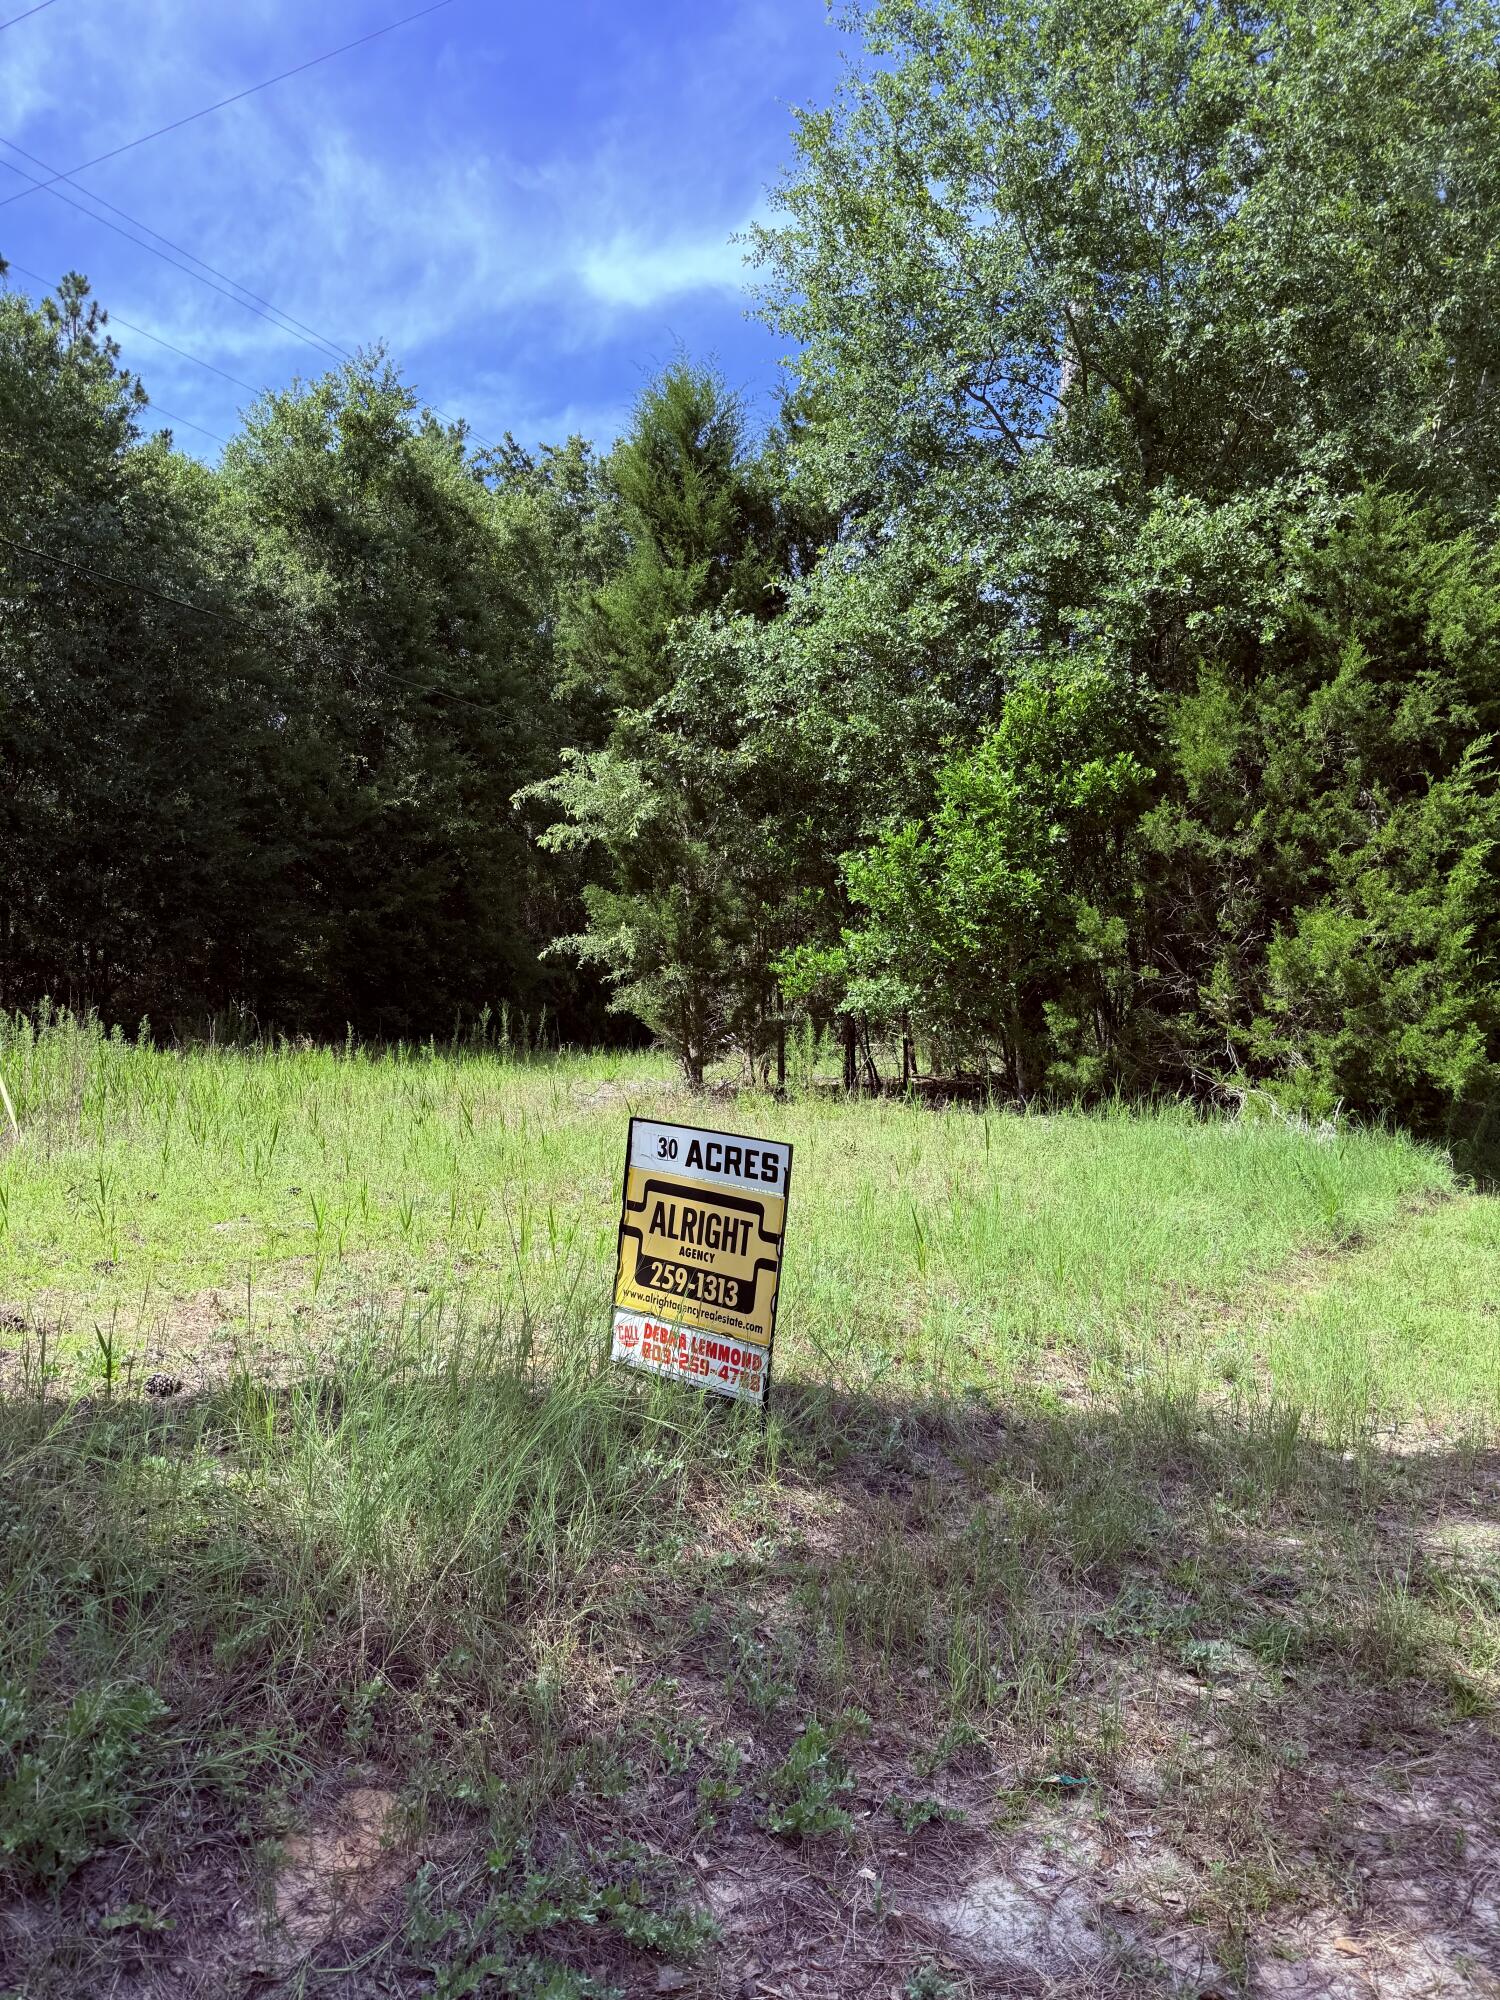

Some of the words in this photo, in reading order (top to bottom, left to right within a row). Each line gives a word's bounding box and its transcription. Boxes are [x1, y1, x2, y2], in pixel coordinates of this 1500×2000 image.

[657, 1137, 678, 1159] 30
[685, 1140, 779, 1183] ACRES
[649, 1201, 753, 1256] ALRIGHT
[679, 1246, 715, 1263] AGENCY
[650, 1262, 739, 1307] 259-1313
[617, 1324, 639, 1341] CALL
